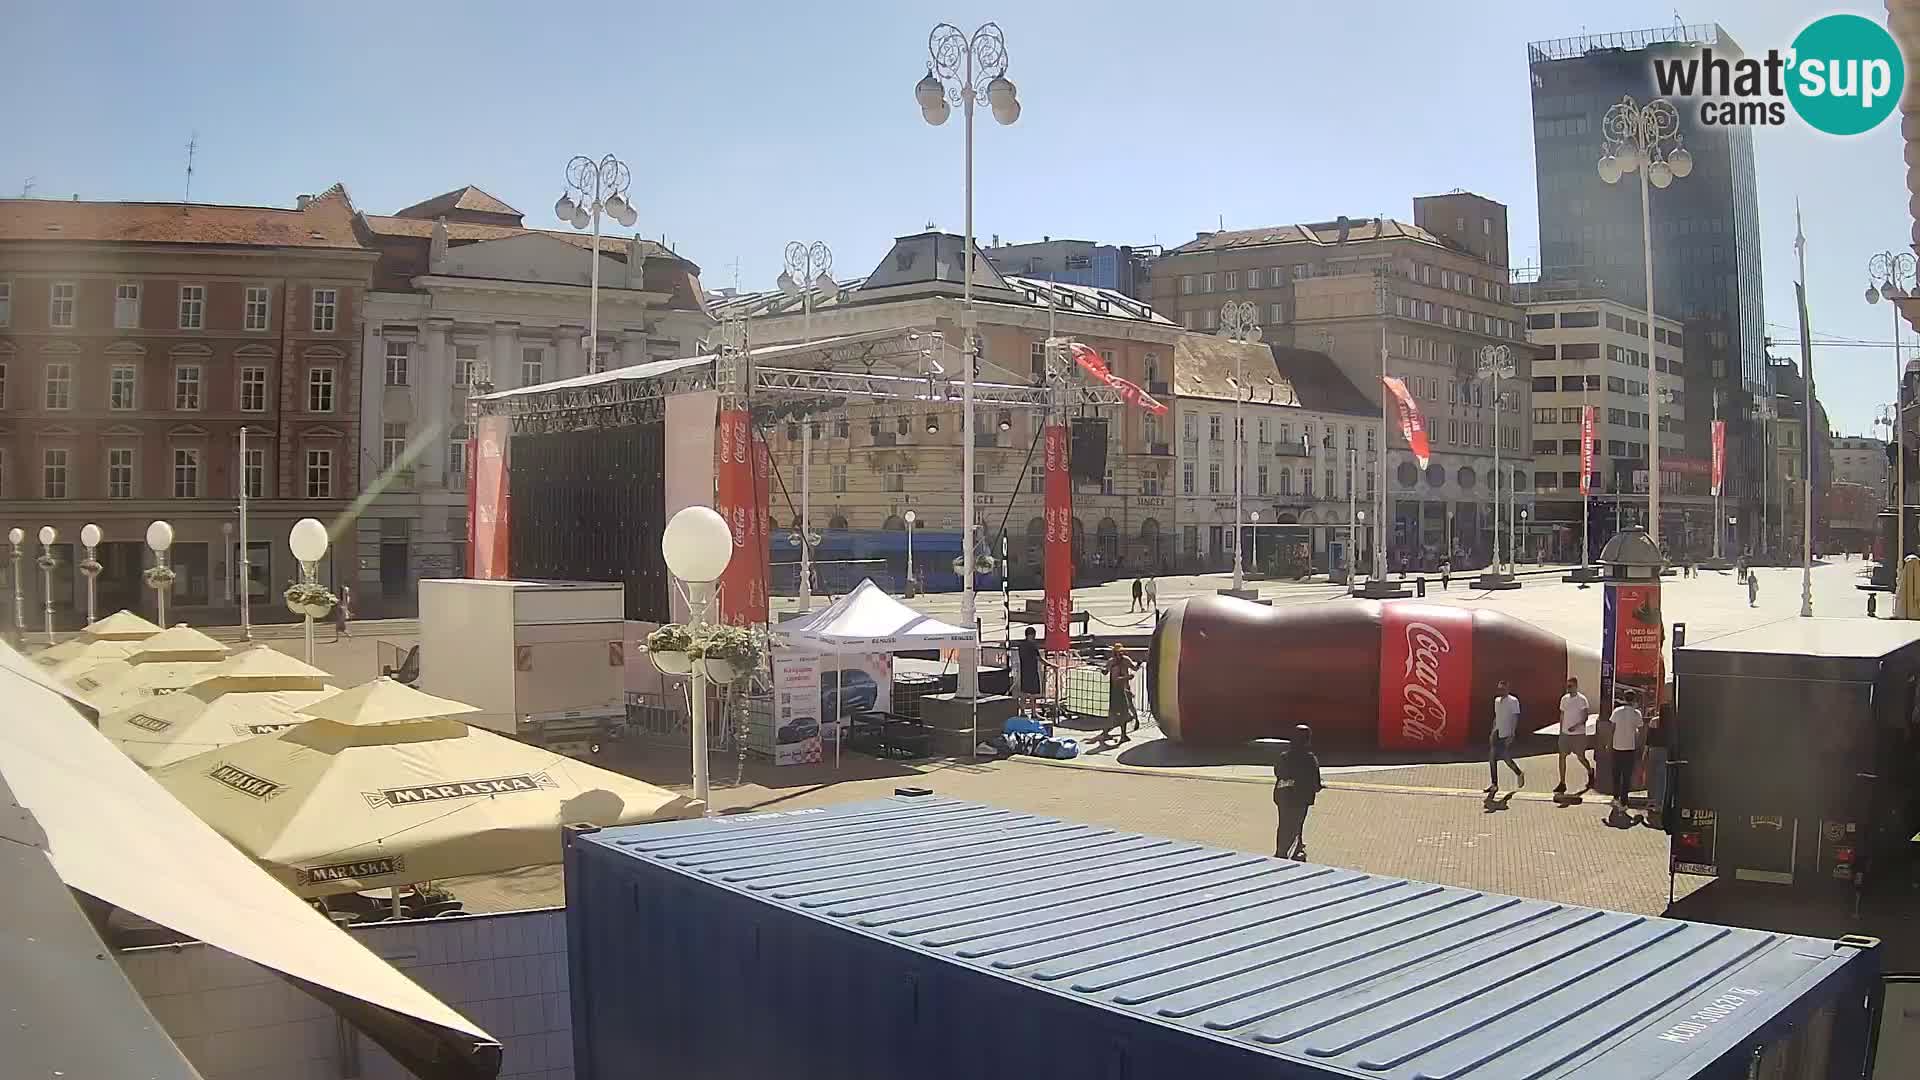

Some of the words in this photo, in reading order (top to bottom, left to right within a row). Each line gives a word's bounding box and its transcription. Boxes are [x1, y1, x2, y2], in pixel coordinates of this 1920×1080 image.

[960, 495, 994, 504] SGER
[733, 503, 745, 548] Coca-Cola
[1403, 622, 1450, 742] Coca-Cola
[395, 778, 531, 803] MARASKA
[313, 861, 390, 881] MARASKA
